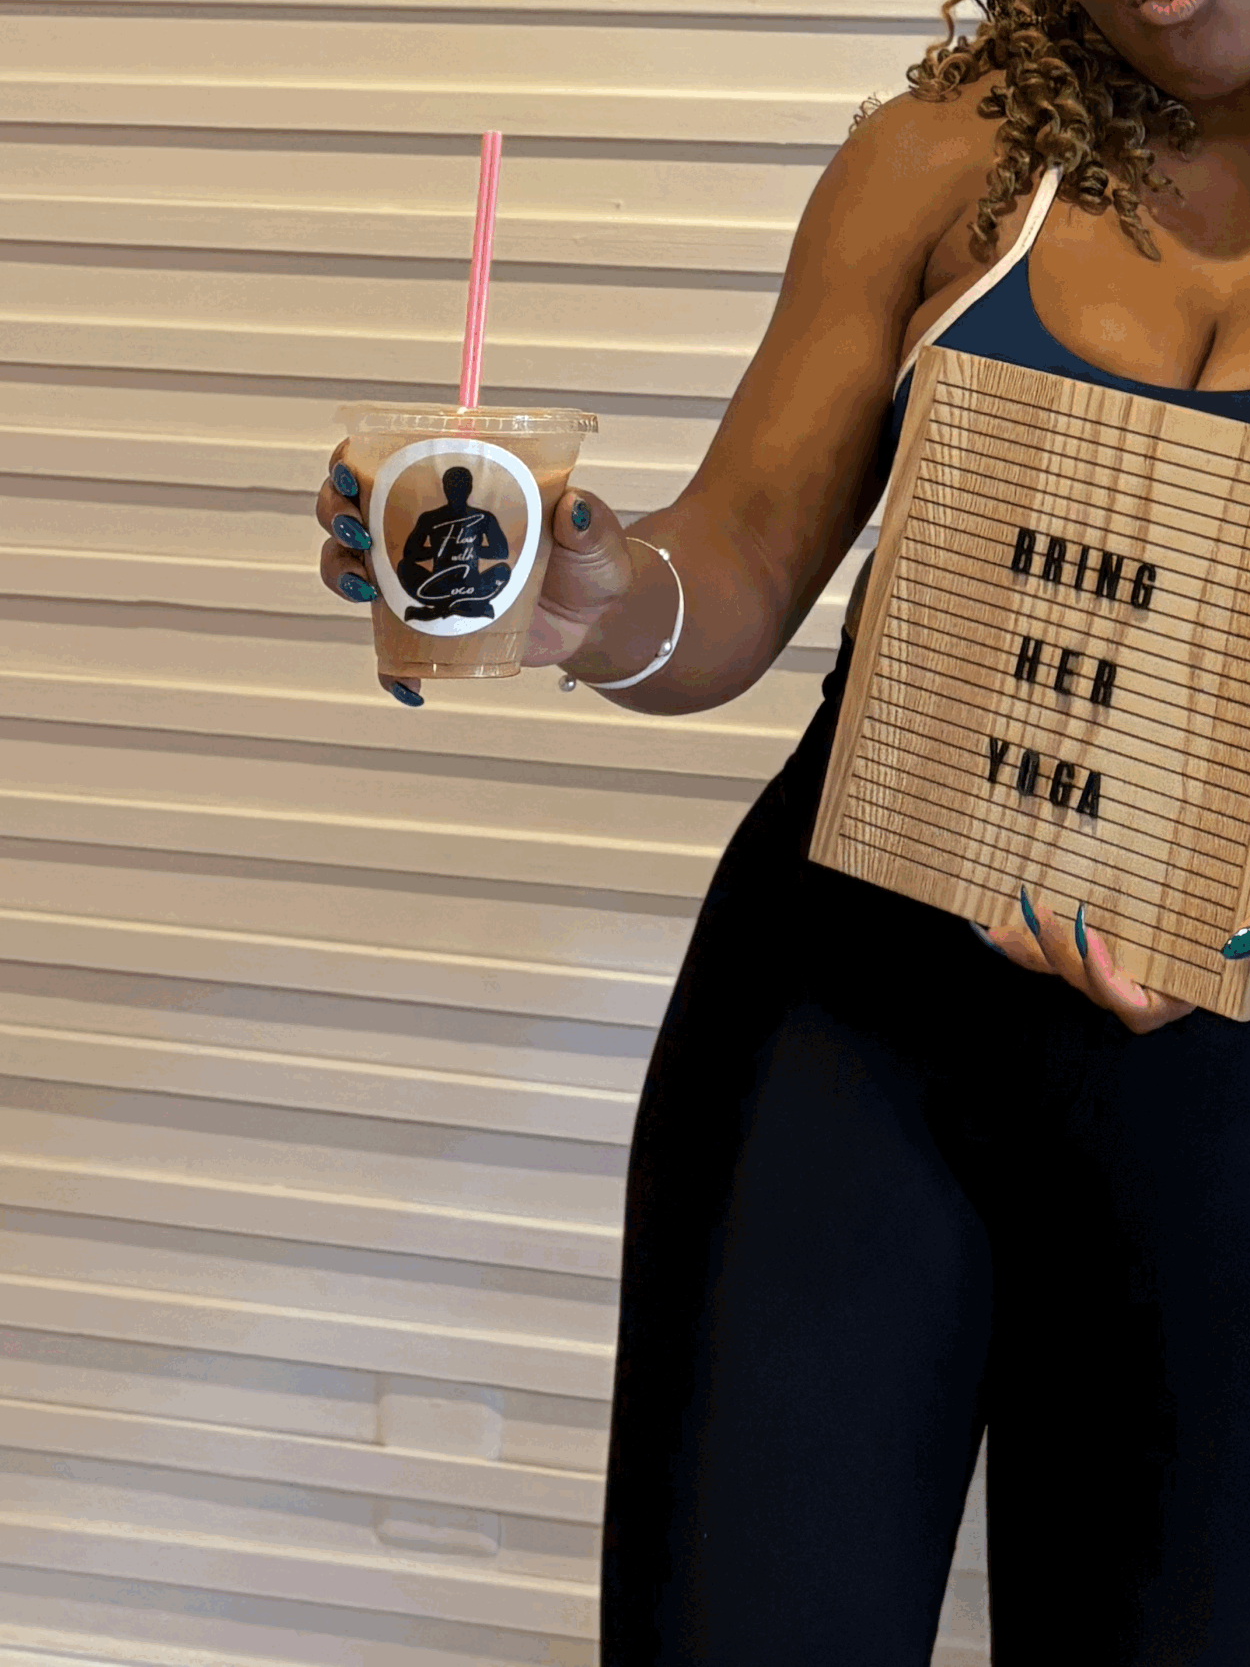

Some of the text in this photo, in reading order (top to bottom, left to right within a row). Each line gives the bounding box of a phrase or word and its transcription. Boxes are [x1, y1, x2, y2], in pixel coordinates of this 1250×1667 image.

[1011, 526, 1157, 610] BRING
[1014, 635, 1117, 708] HER
[987, 736, 1102, 818] YOGA
